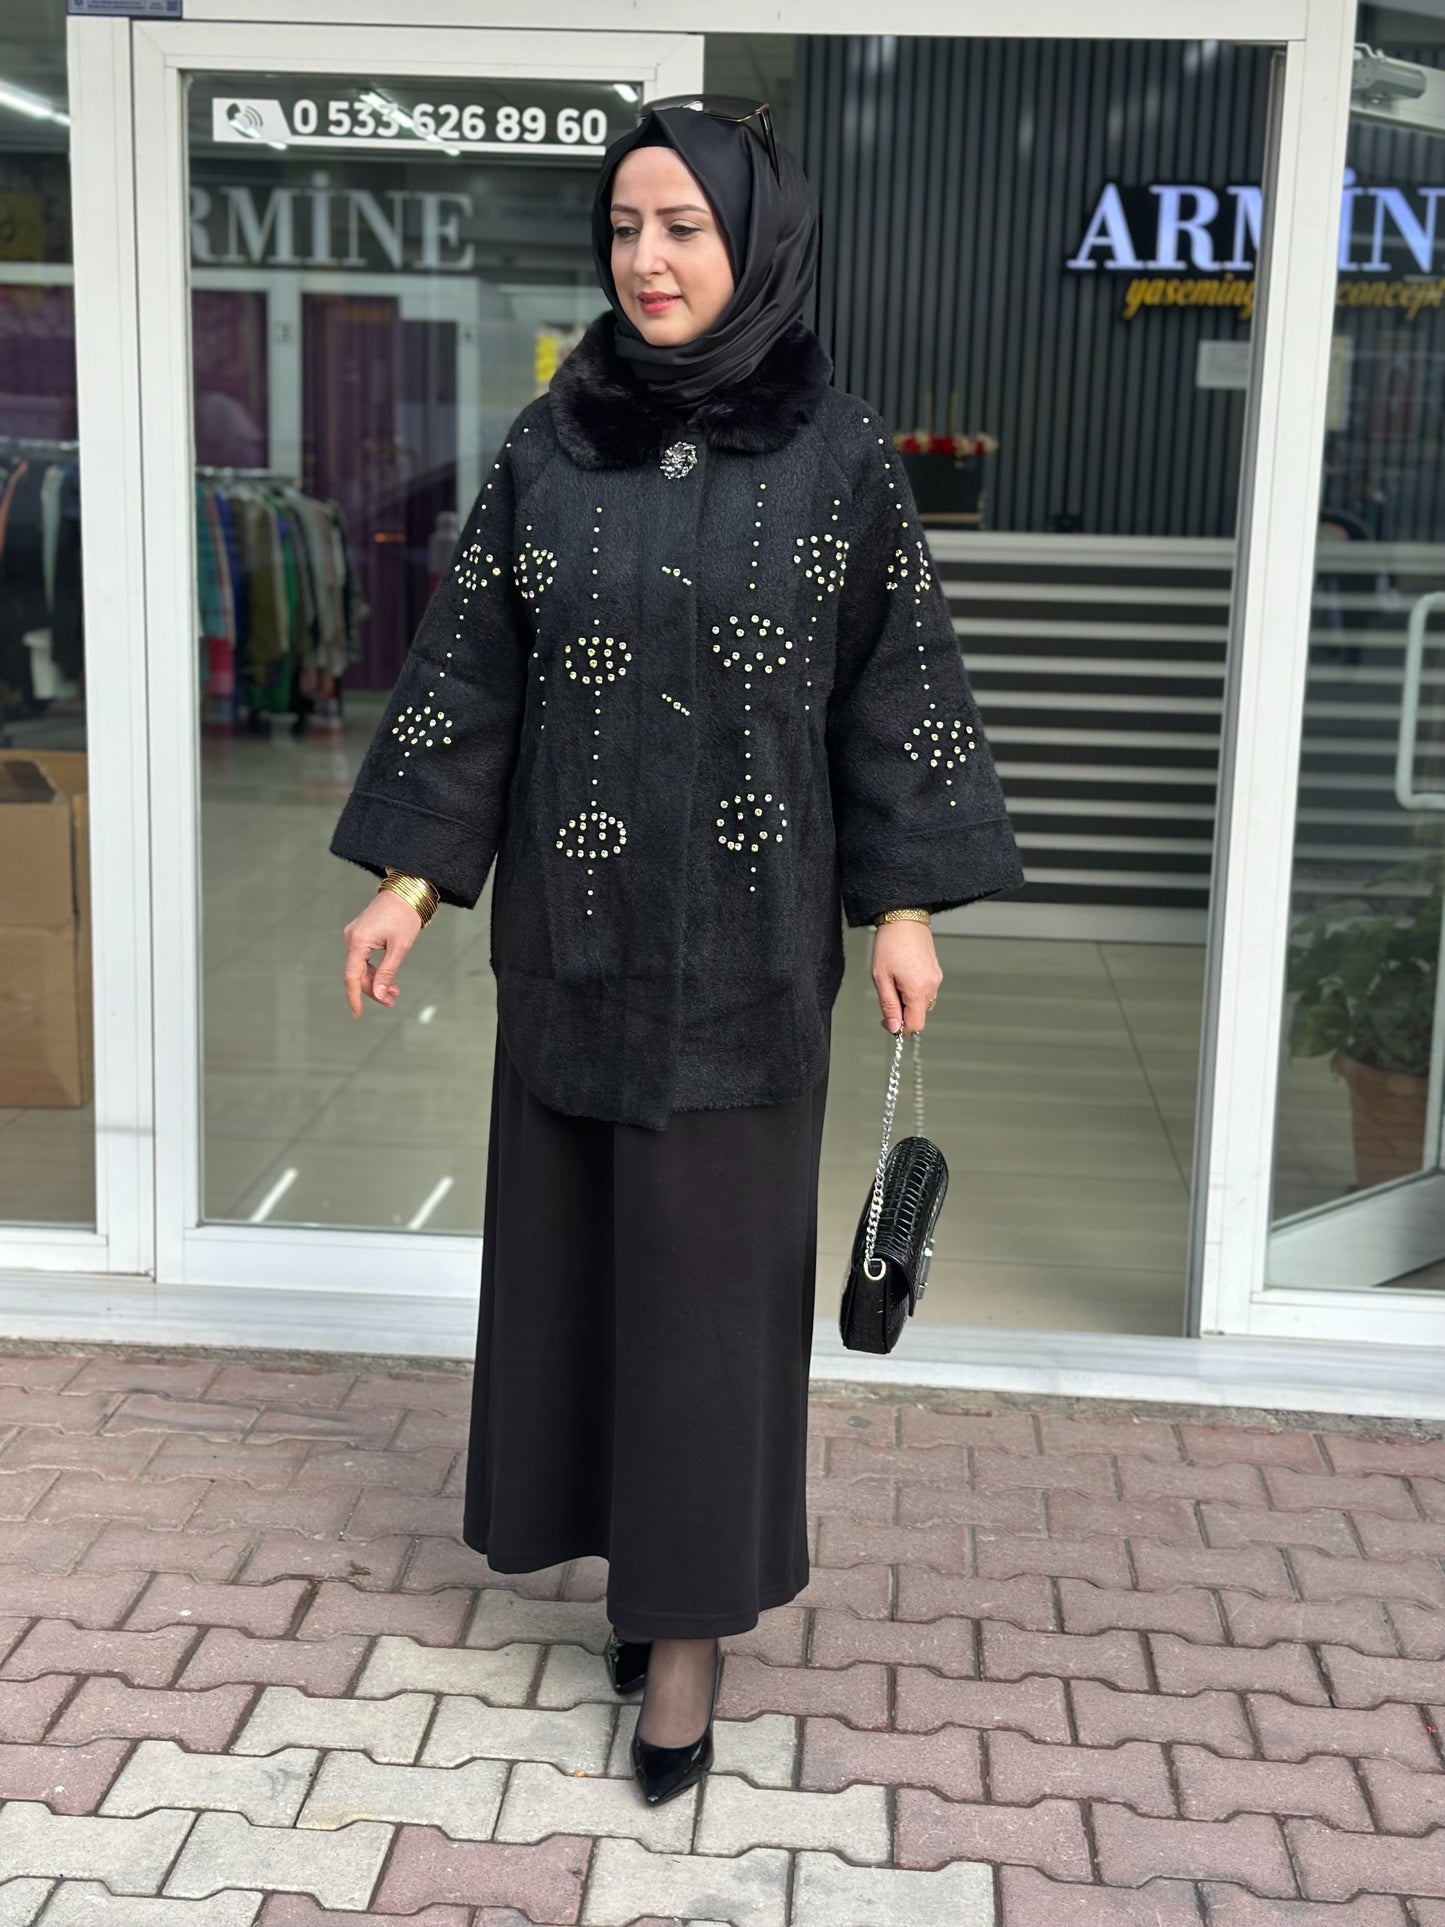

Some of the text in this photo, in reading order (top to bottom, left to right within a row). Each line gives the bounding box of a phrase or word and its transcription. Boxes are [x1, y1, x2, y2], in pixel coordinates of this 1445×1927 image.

[293, 99, 608, 145] 0 533 626 89 60
